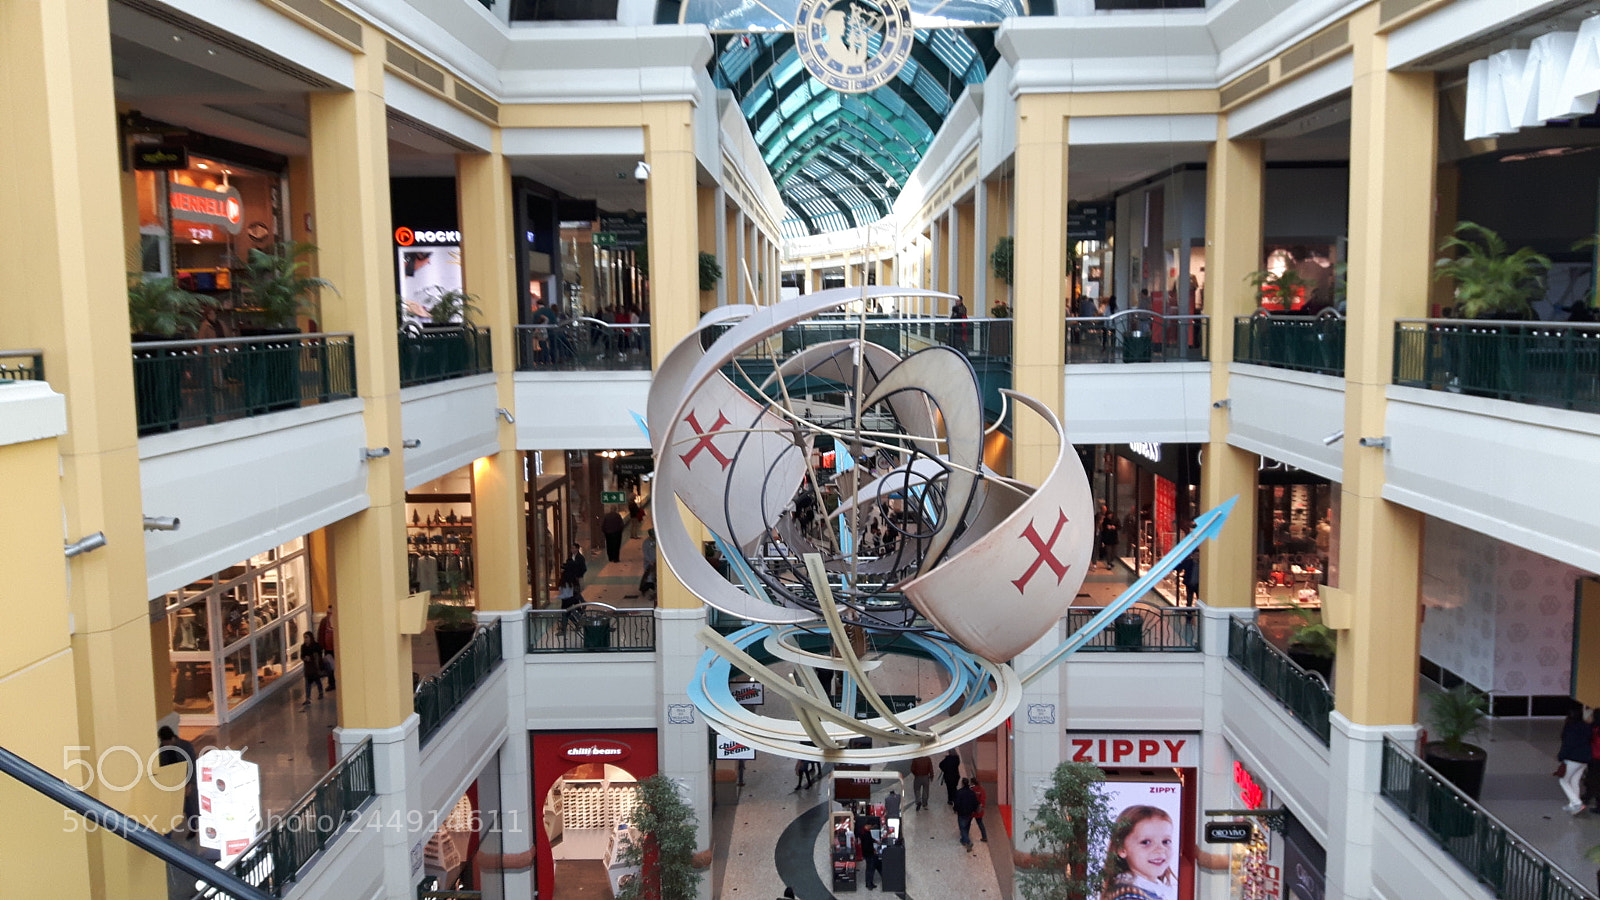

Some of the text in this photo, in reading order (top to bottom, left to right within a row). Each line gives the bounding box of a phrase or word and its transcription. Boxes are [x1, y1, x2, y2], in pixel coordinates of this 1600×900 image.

[567, 747, 622, 756] chilli beans
[1072, 739, 1186, 763] ZIPPY
